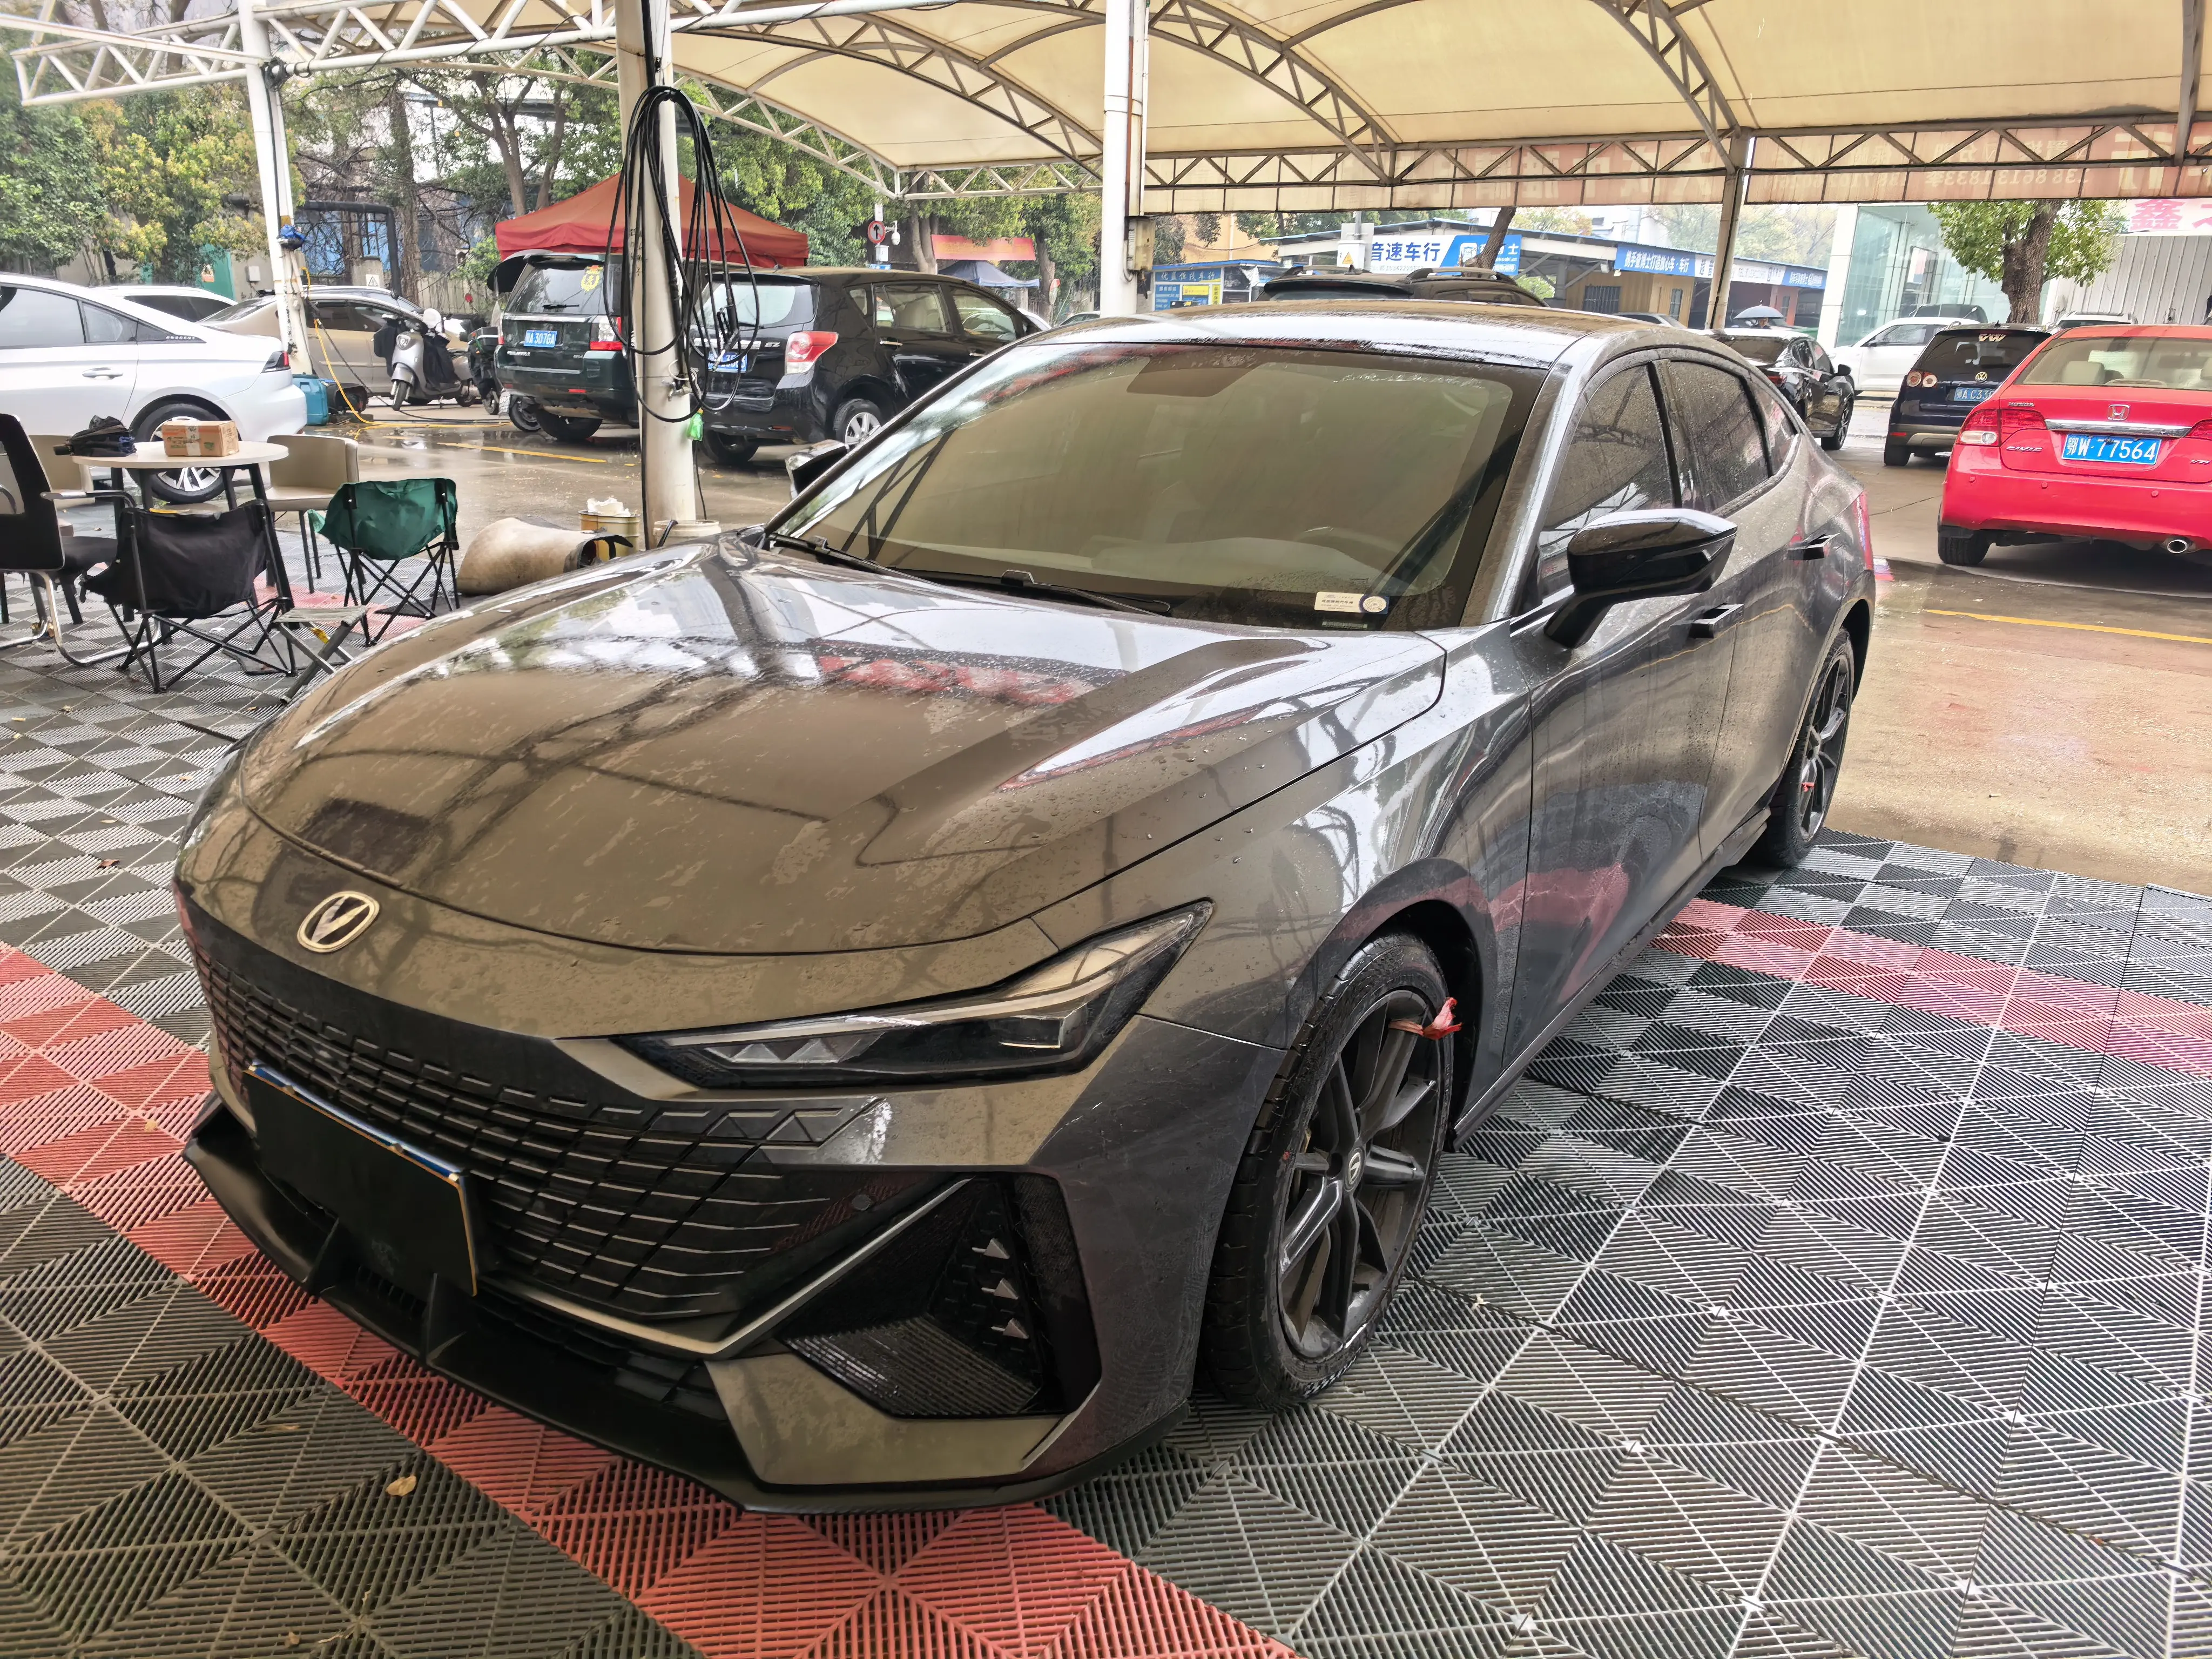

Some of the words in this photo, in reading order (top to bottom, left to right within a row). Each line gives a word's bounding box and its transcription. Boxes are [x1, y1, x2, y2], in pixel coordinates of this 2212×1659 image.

[1371, 242, 1440, 262] 音速车行
[1979, 334, 2007, 342] VW
